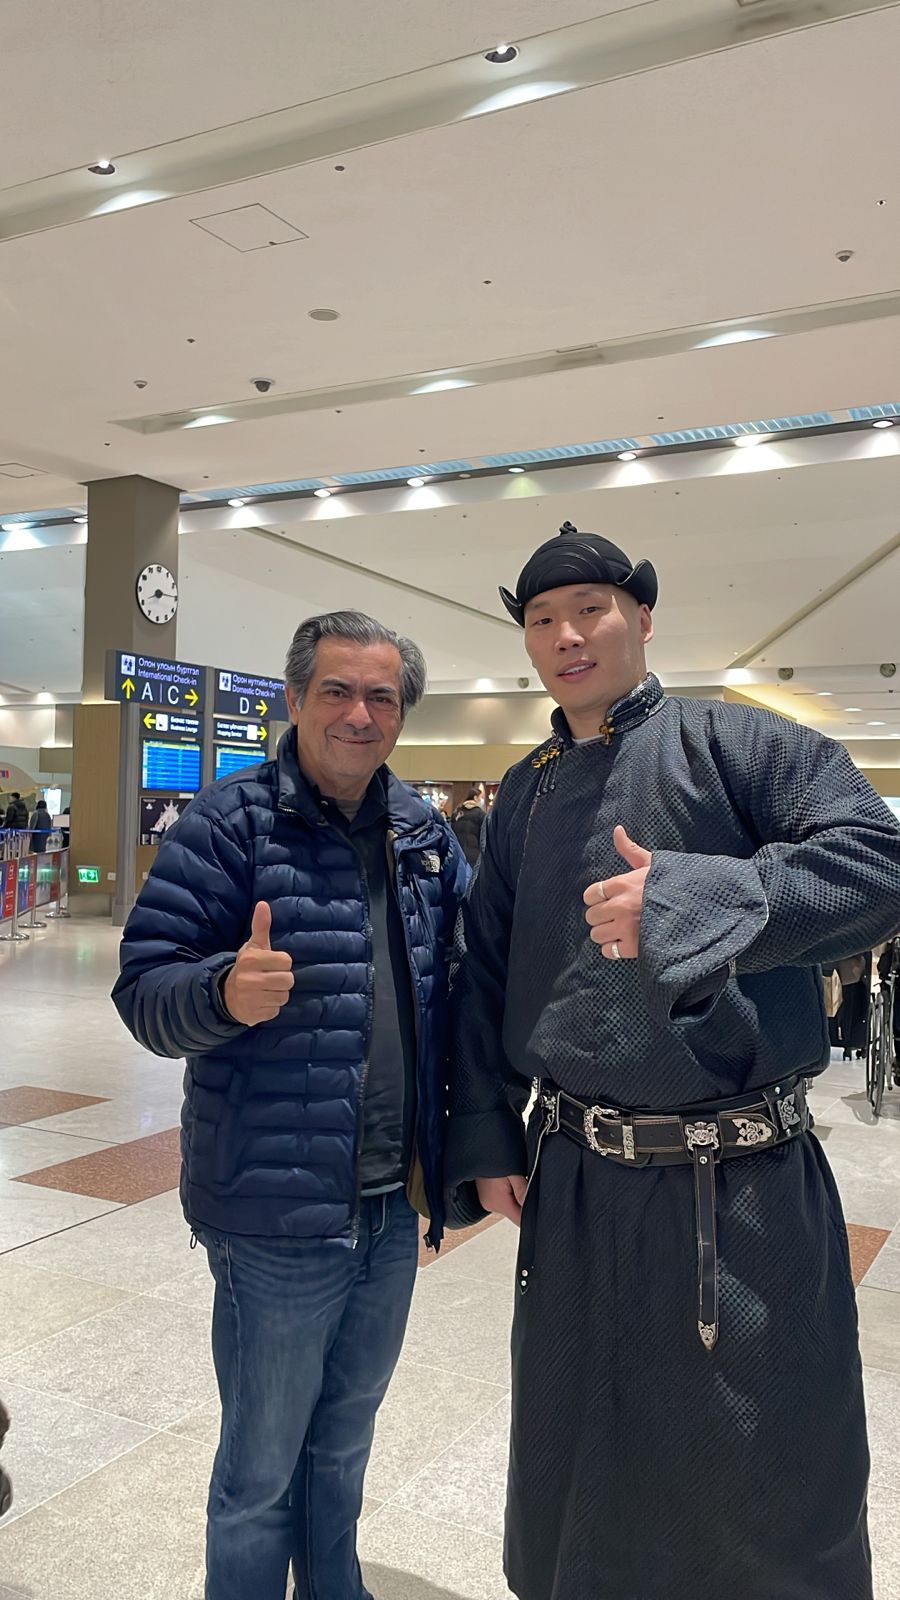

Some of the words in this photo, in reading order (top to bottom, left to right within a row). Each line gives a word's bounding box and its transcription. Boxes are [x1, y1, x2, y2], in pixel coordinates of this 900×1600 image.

[138, 657, 155, 667] Олон
[156, 661, 176, 671] улсын
[138, 669, 172, 682] International
[173, 674, 197, 686] Check-in
[141, 681, 153, 701] A
[167, 685, 179, 705] C
[232, 684, 254, 695] Domestic
[255, 687, 276, 699] Check-in
[240, 696, 250, 714] D
